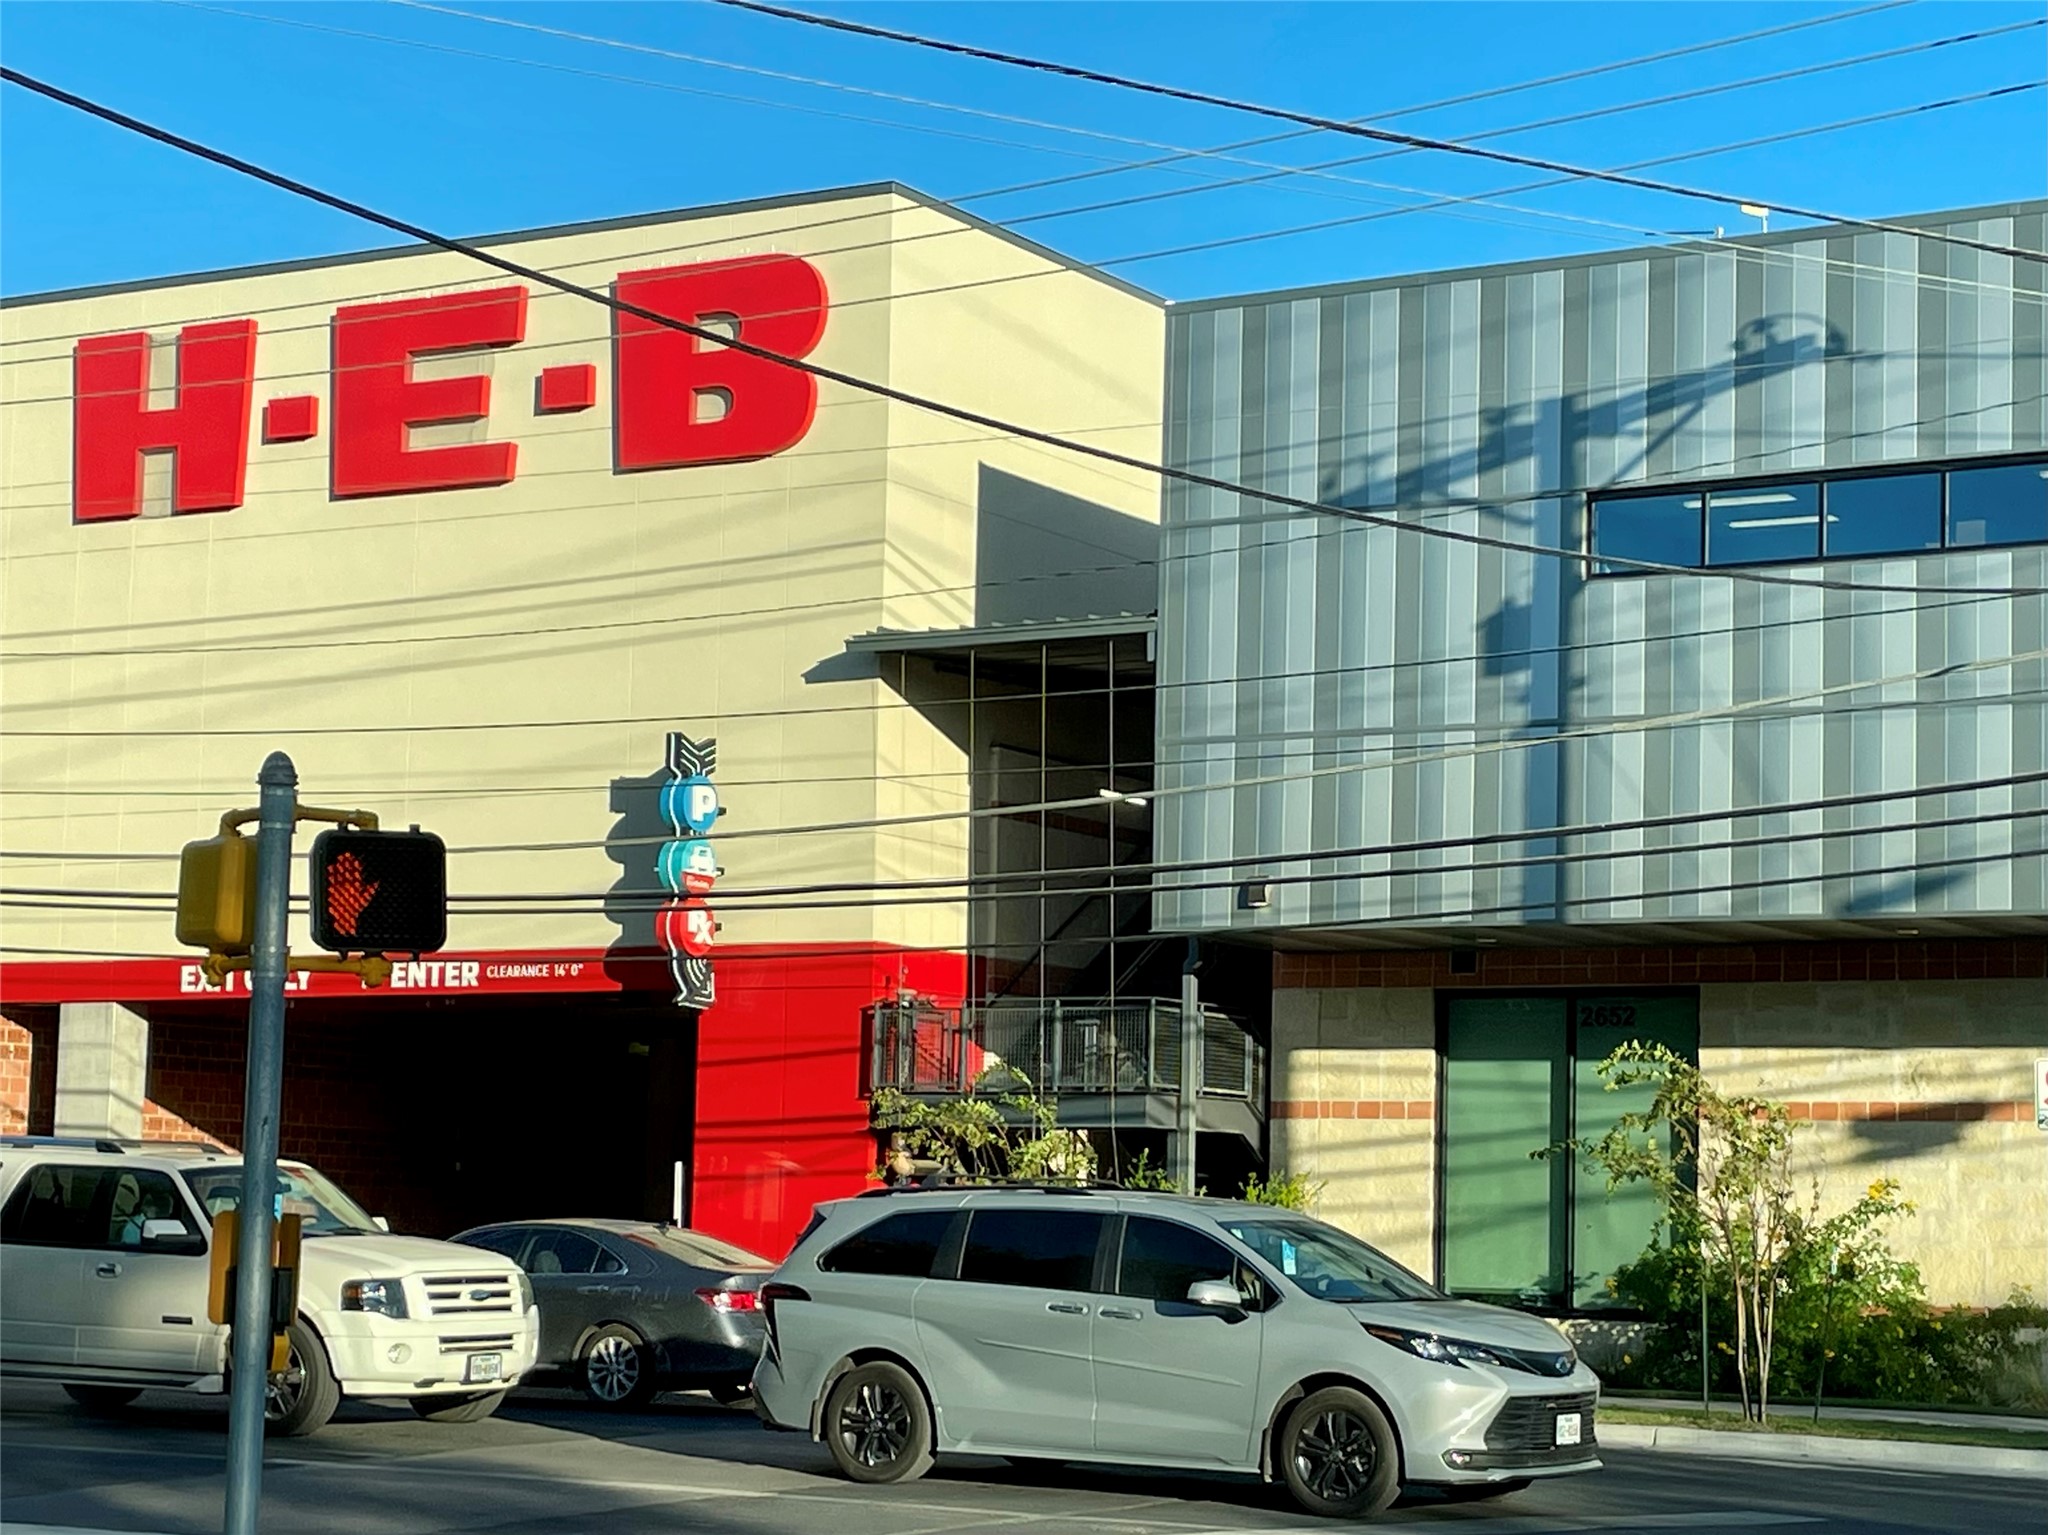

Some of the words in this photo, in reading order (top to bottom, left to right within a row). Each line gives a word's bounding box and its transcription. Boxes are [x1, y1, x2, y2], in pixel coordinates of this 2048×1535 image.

[74, 253, 829, 525] H-E-B
[692, 784, 717, 822] P
[180, 964, 234, 993] EXT
[390, 961, 480, 988] ENTER
[486, 964, 550, 979] CLEARANCE
[1580, 1005, 1636, 1027] 2652
